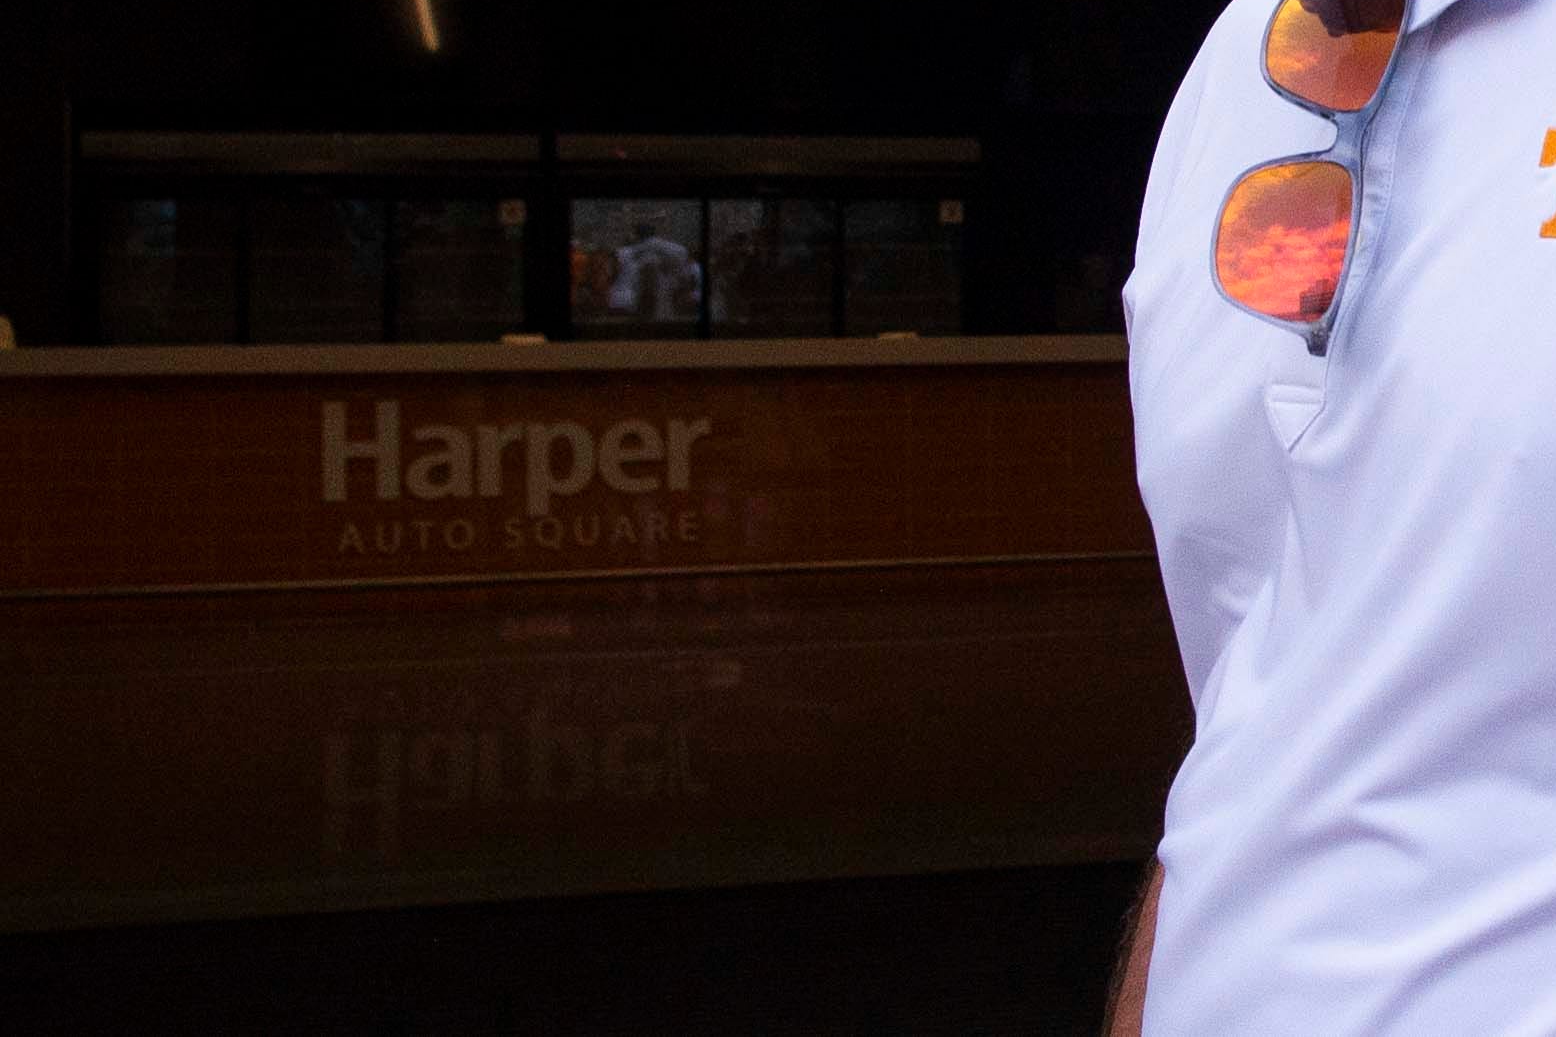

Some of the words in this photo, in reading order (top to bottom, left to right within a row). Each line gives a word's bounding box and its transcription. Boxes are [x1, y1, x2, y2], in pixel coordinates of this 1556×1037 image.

[321, 400, 712, 516] Harper
[337, 519, 476, 554] AUTO
[504, 510, 699, 550] SQUARE
